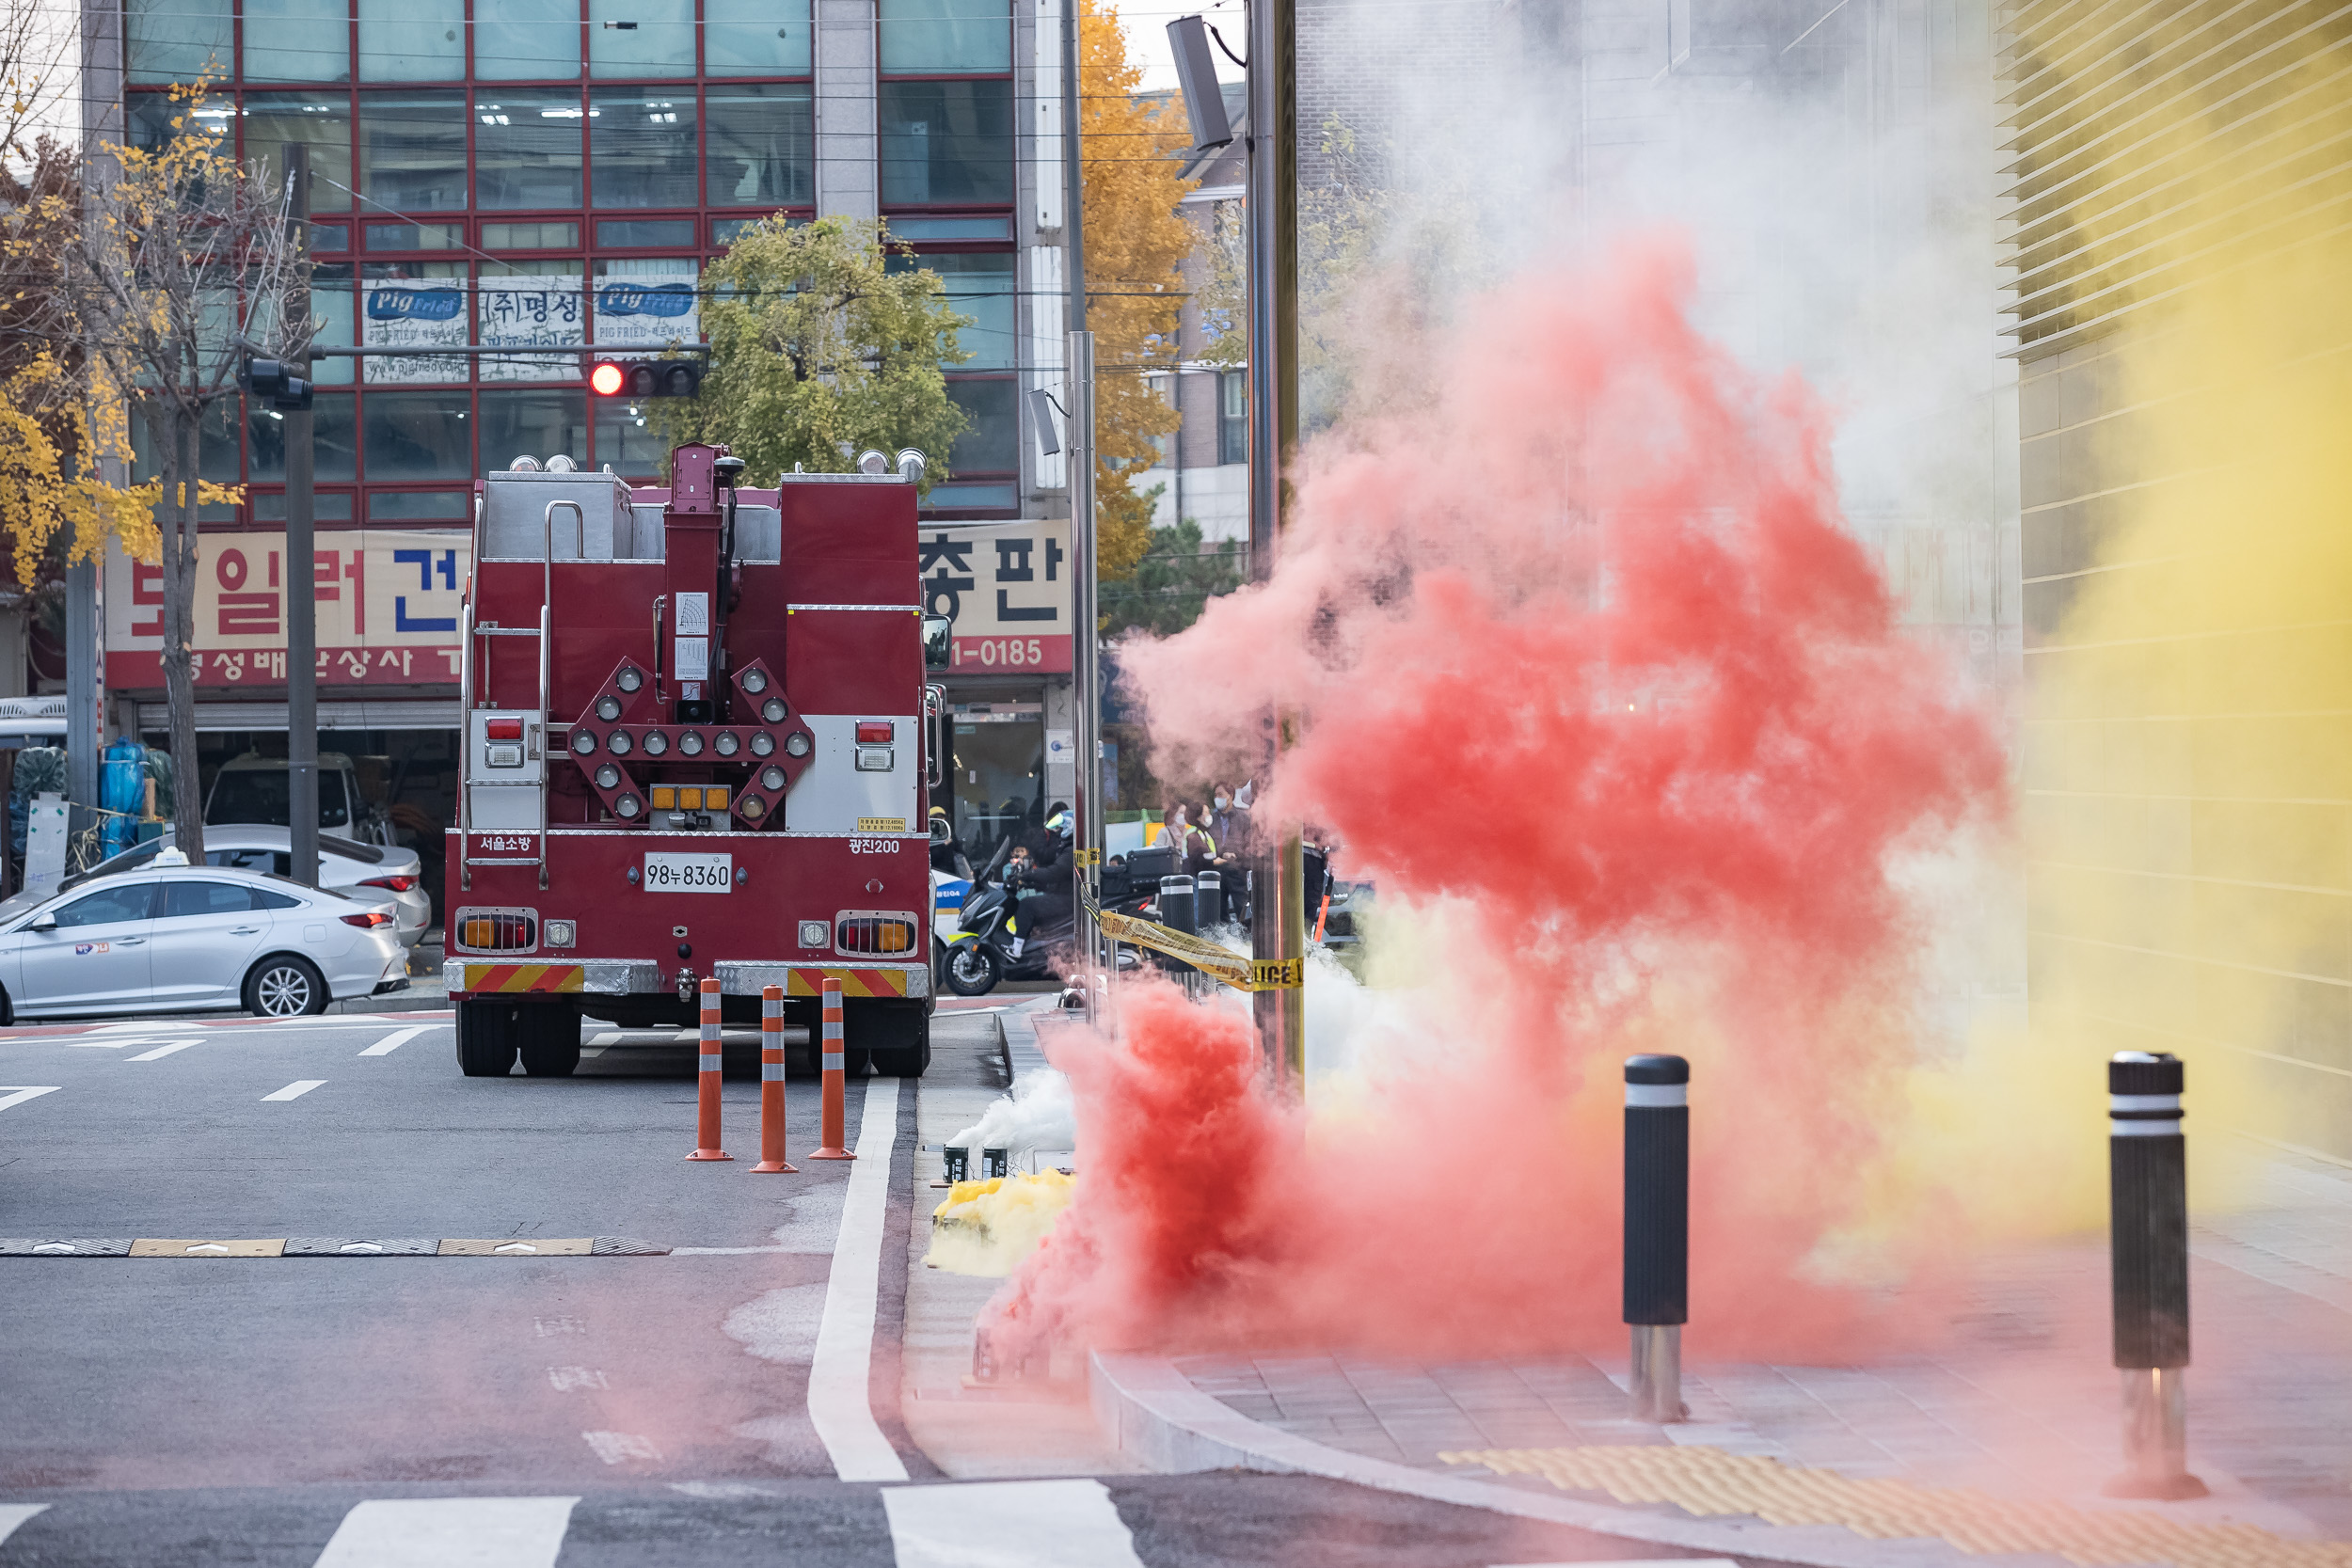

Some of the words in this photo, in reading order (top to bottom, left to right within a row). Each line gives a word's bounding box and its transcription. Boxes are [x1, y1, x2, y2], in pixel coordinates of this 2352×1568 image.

[377, 292, 413, 313] Pig
[486, 291, 577, 323] (주)명성
[599, 326, 615, 338] PIG
[480, 835, 532, 851] 서울소방
[849, 839, 899, 854] 광진200
[1253, 965, 1292, 984] LICE
